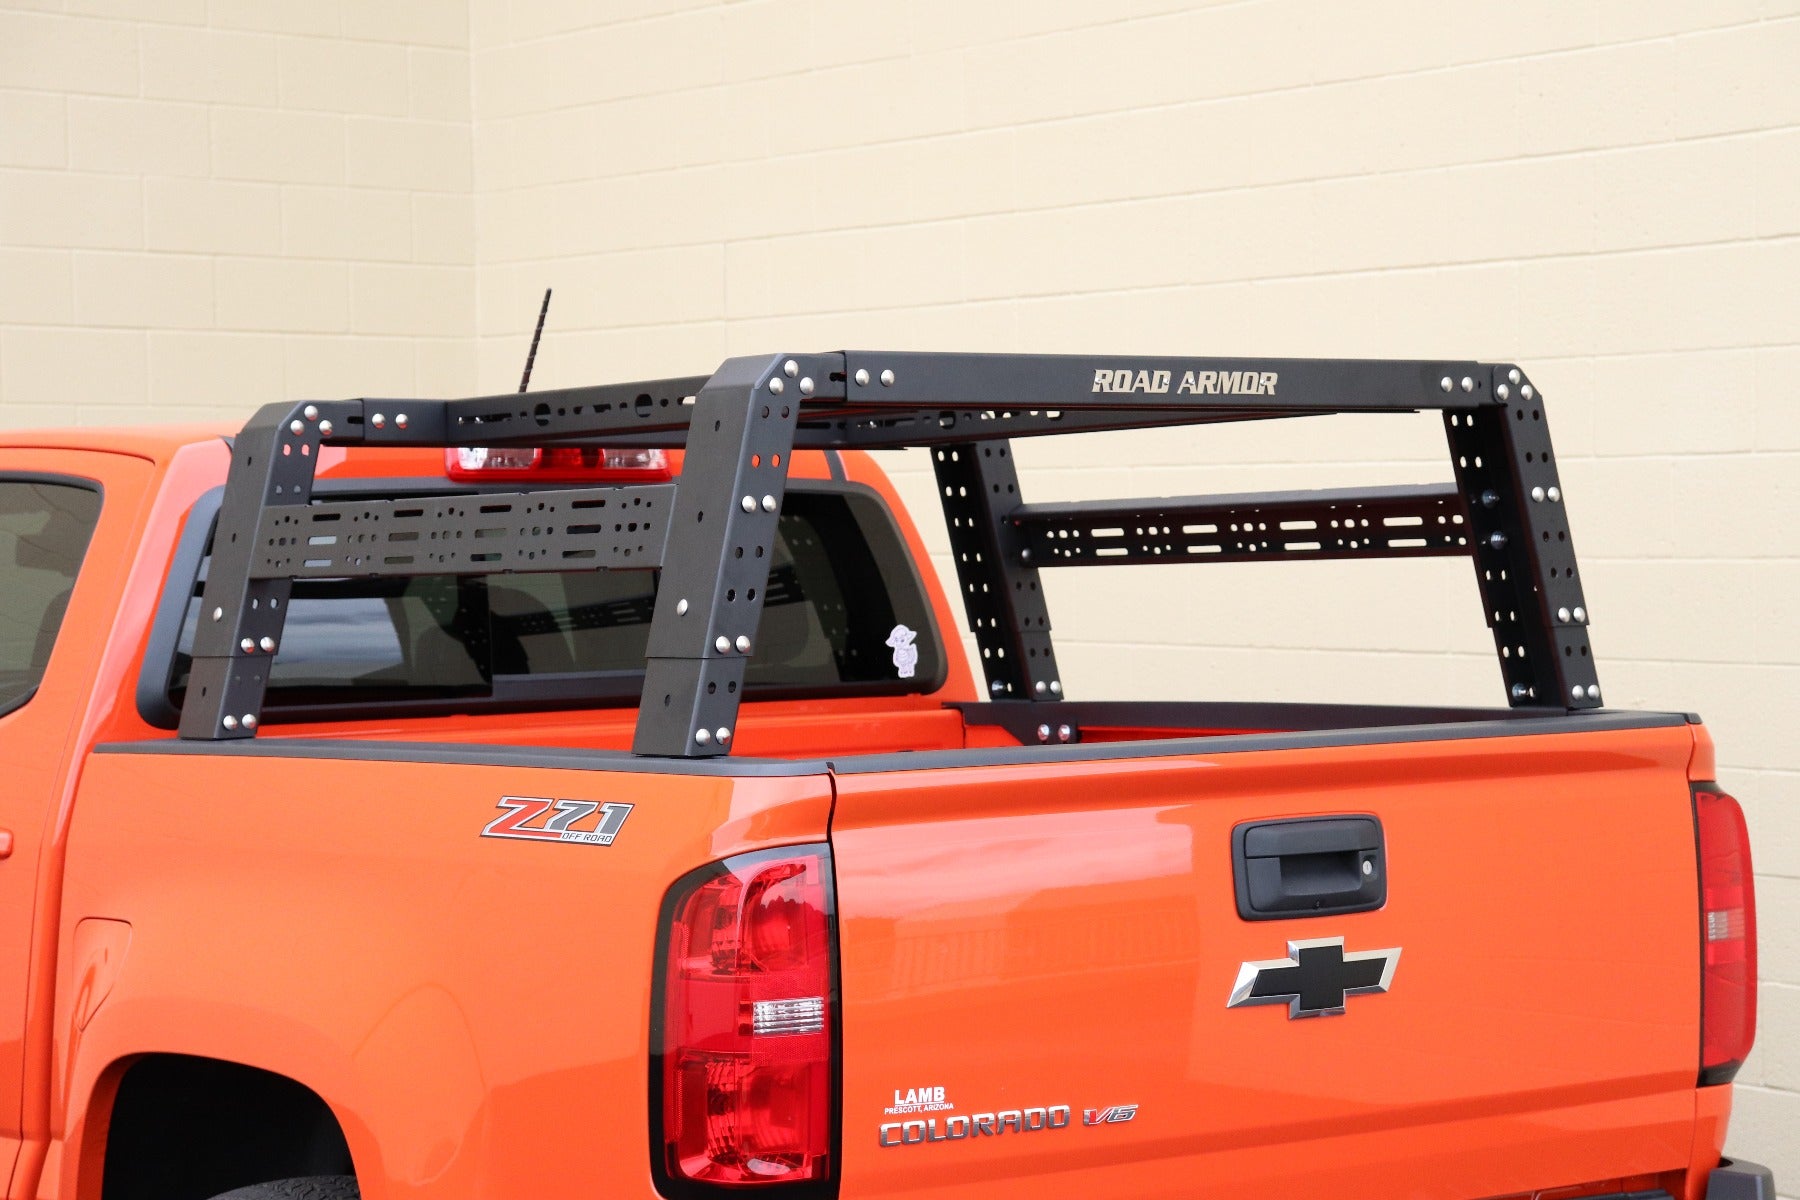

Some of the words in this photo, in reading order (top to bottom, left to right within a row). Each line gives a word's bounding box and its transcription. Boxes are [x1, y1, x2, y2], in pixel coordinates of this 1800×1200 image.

[1092, 369, 1171, 394] ROAD
[1177, 370, 1279, 395] ARMOR
[480, 795, 635, 846] Z71
[561, 832, 582, 841] OFF
[583, 833, 613, 843] ROAD
[894, 1086, 945, 1105] LAMB
[884, 1104, 924, 1115] PRESCOTT,
[924, 1102, 954, 1113] ARIZONA
[879, 1104, 1070, 1147] COLORADO
[1082, 1104, 1139, 1126] V6
